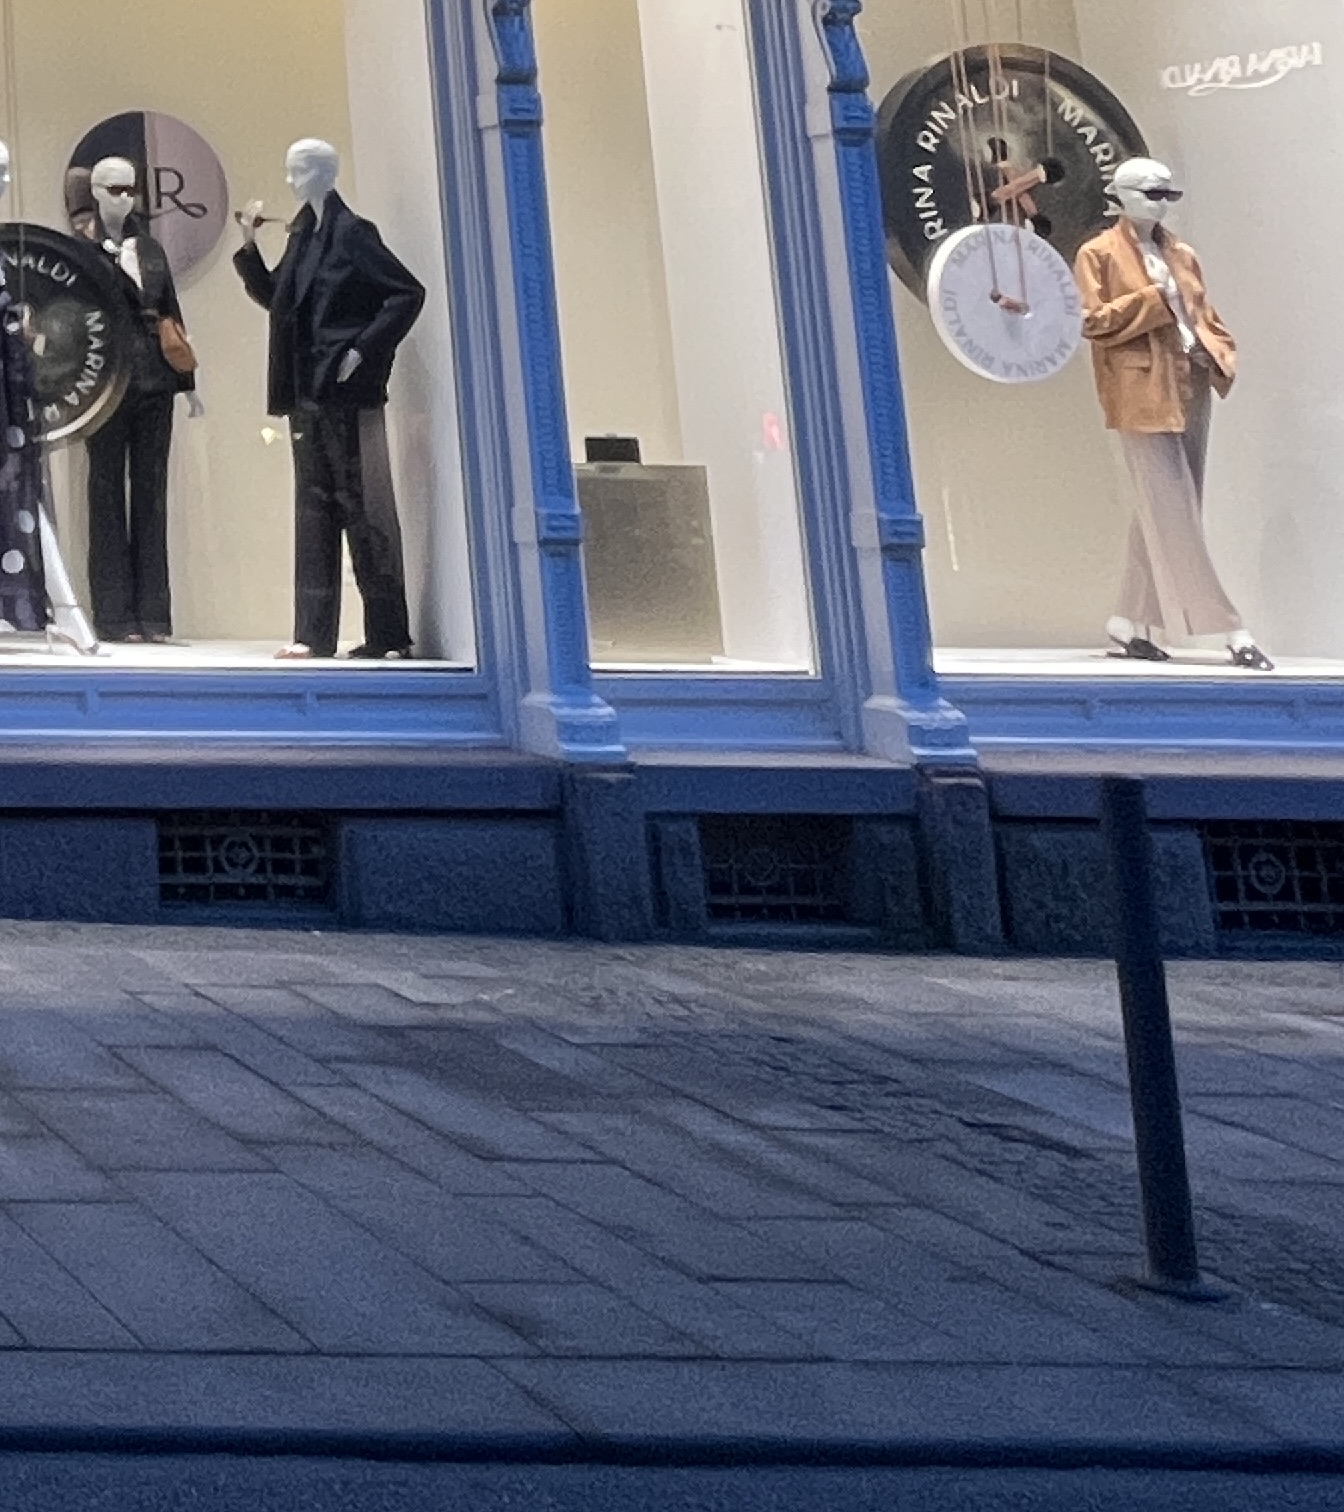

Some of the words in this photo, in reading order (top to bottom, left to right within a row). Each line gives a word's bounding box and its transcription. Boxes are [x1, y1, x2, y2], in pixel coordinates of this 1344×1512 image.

[916, 78, 1019, 153] RINALDI
[153, 166, 208, 219] R
[912, 164, 949, 240] RINA
[4, 251, 77, 286] NALDI
[951, 229, 1020, 268] MARINA
[1027, 239, 1081, 317] RINALDI
[64, 311, 105, 406] MARINA
[943, 289, 996, 370] RINALDI
[1002, 338, 1072, 378] MARINA
